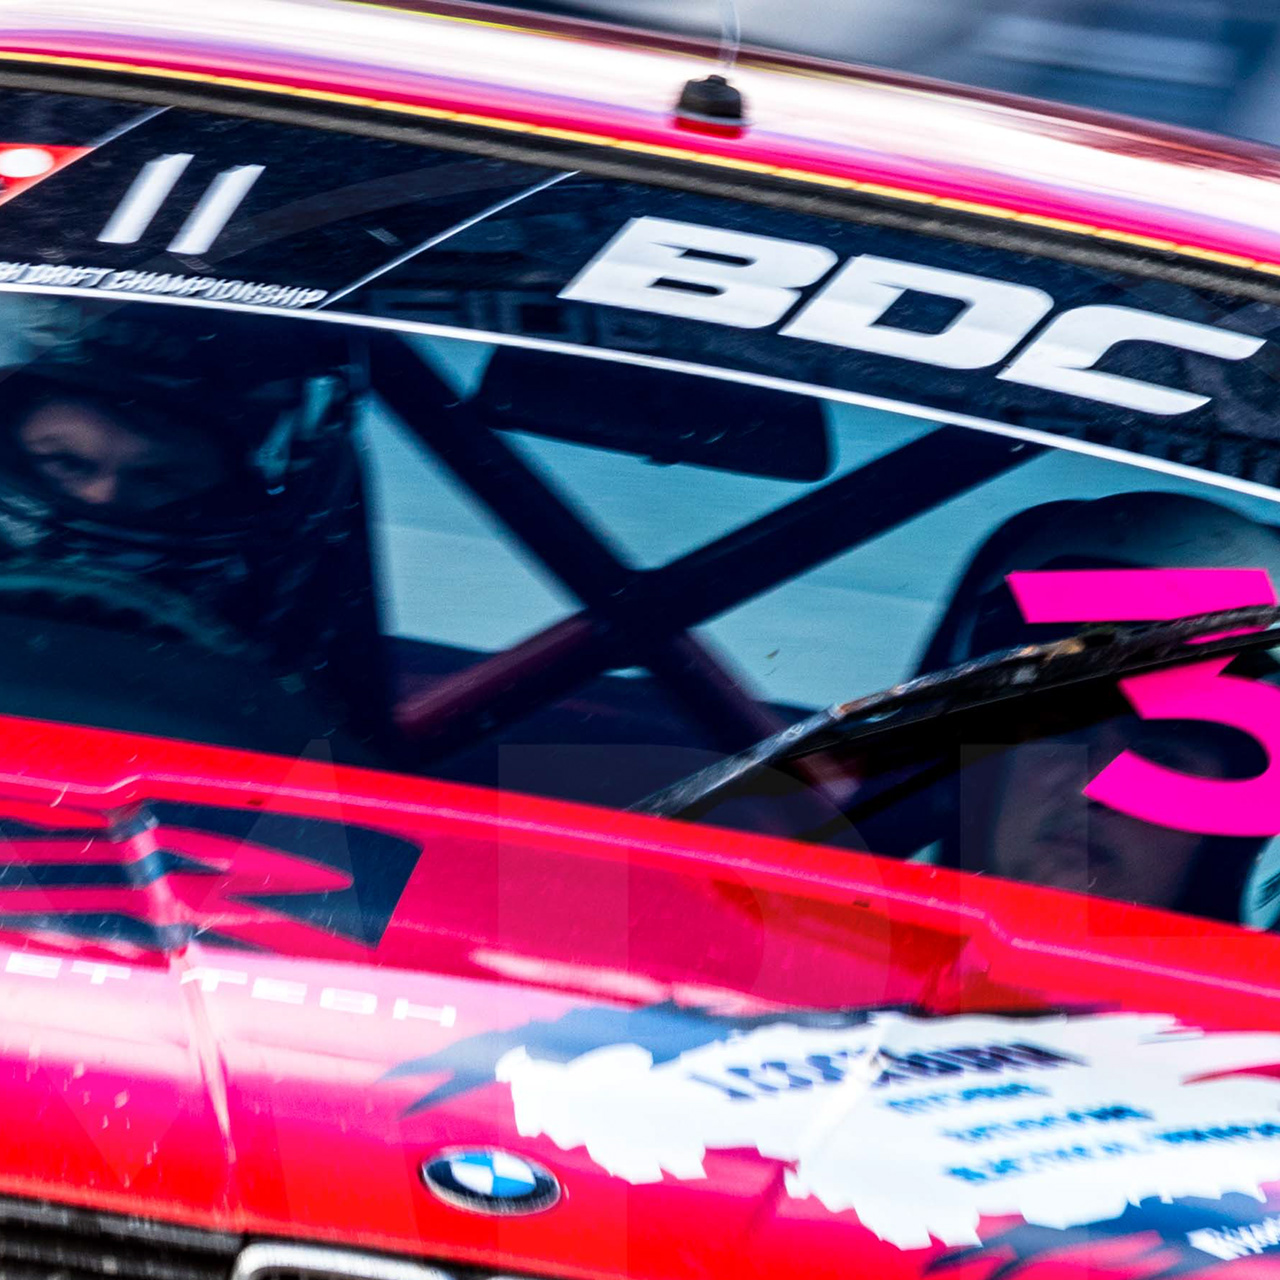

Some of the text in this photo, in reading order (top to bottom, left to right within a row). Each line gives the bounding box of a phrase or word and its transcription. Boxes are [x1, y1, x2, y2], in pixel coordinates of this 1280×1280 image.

[23, 265, 116, 288] DRIFT
[106, 269, 328, 309] CHAMPIONSHIP
[558, 216, 1267, 416] BDC
